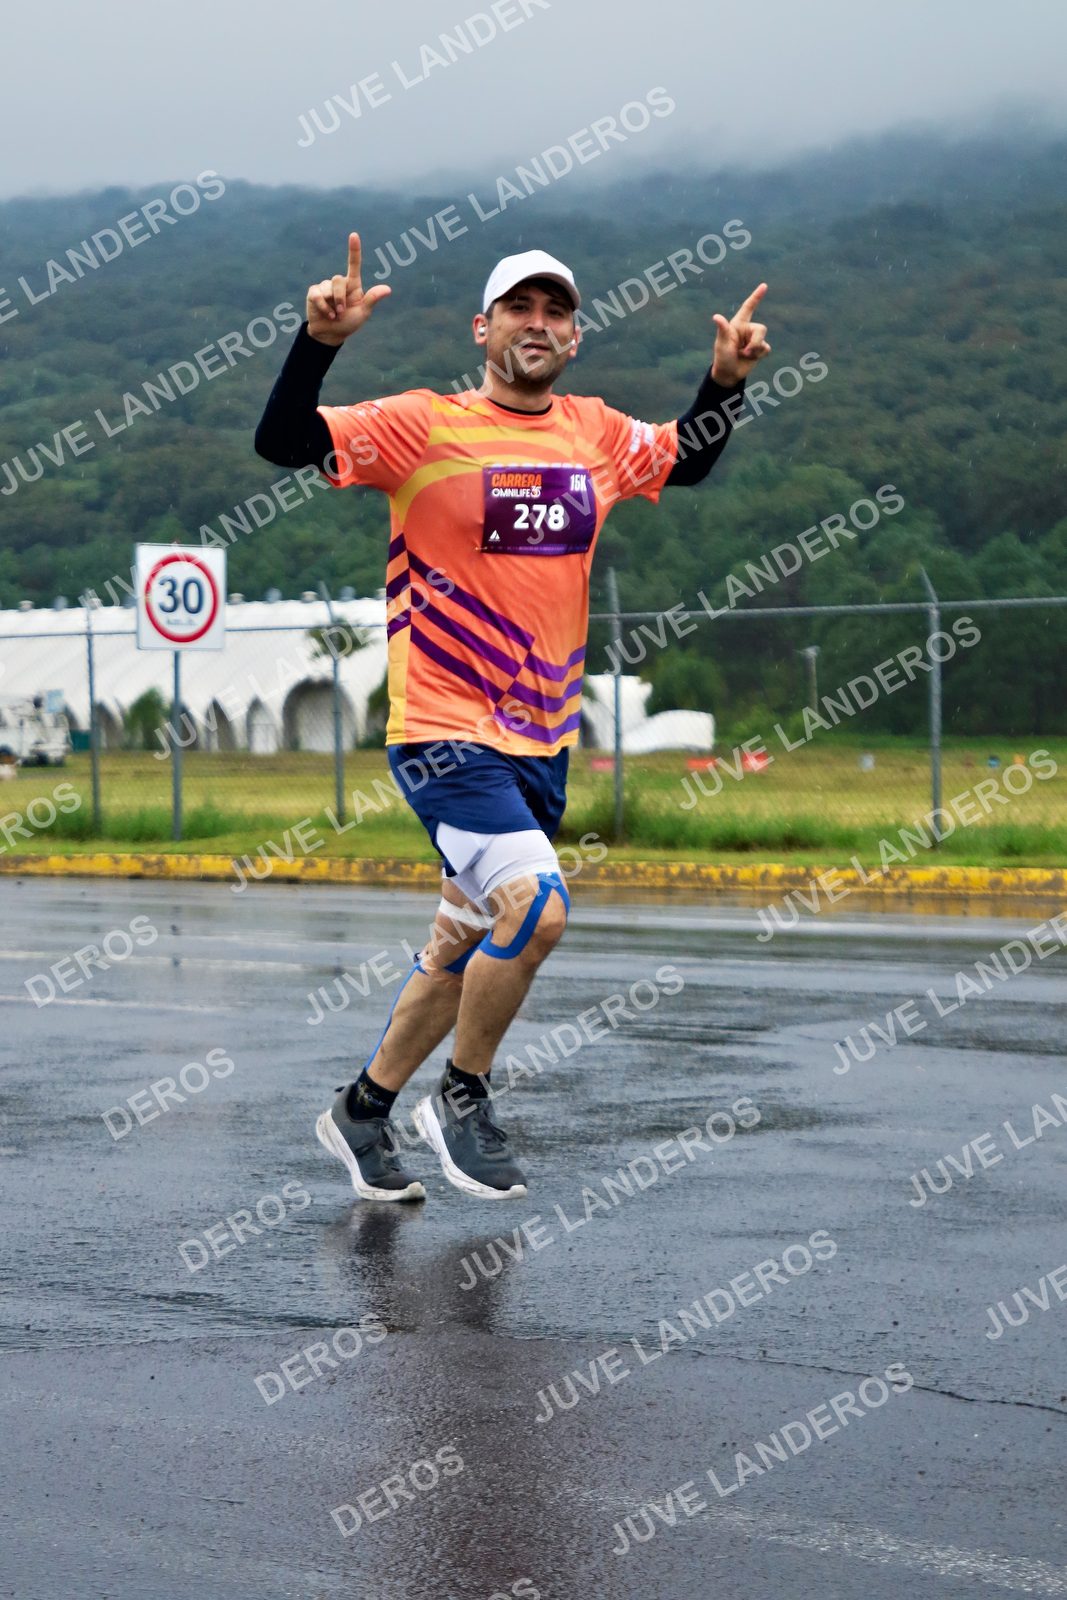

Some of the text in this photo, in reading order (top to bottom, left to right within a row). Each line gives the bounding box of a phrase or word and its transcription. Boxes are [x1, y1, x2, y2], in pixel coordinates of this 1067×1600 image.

[491, 473, 542, 487] CARRERA
[513, 503, 565, 531] 278
[158, 576, 204, 615] 30
